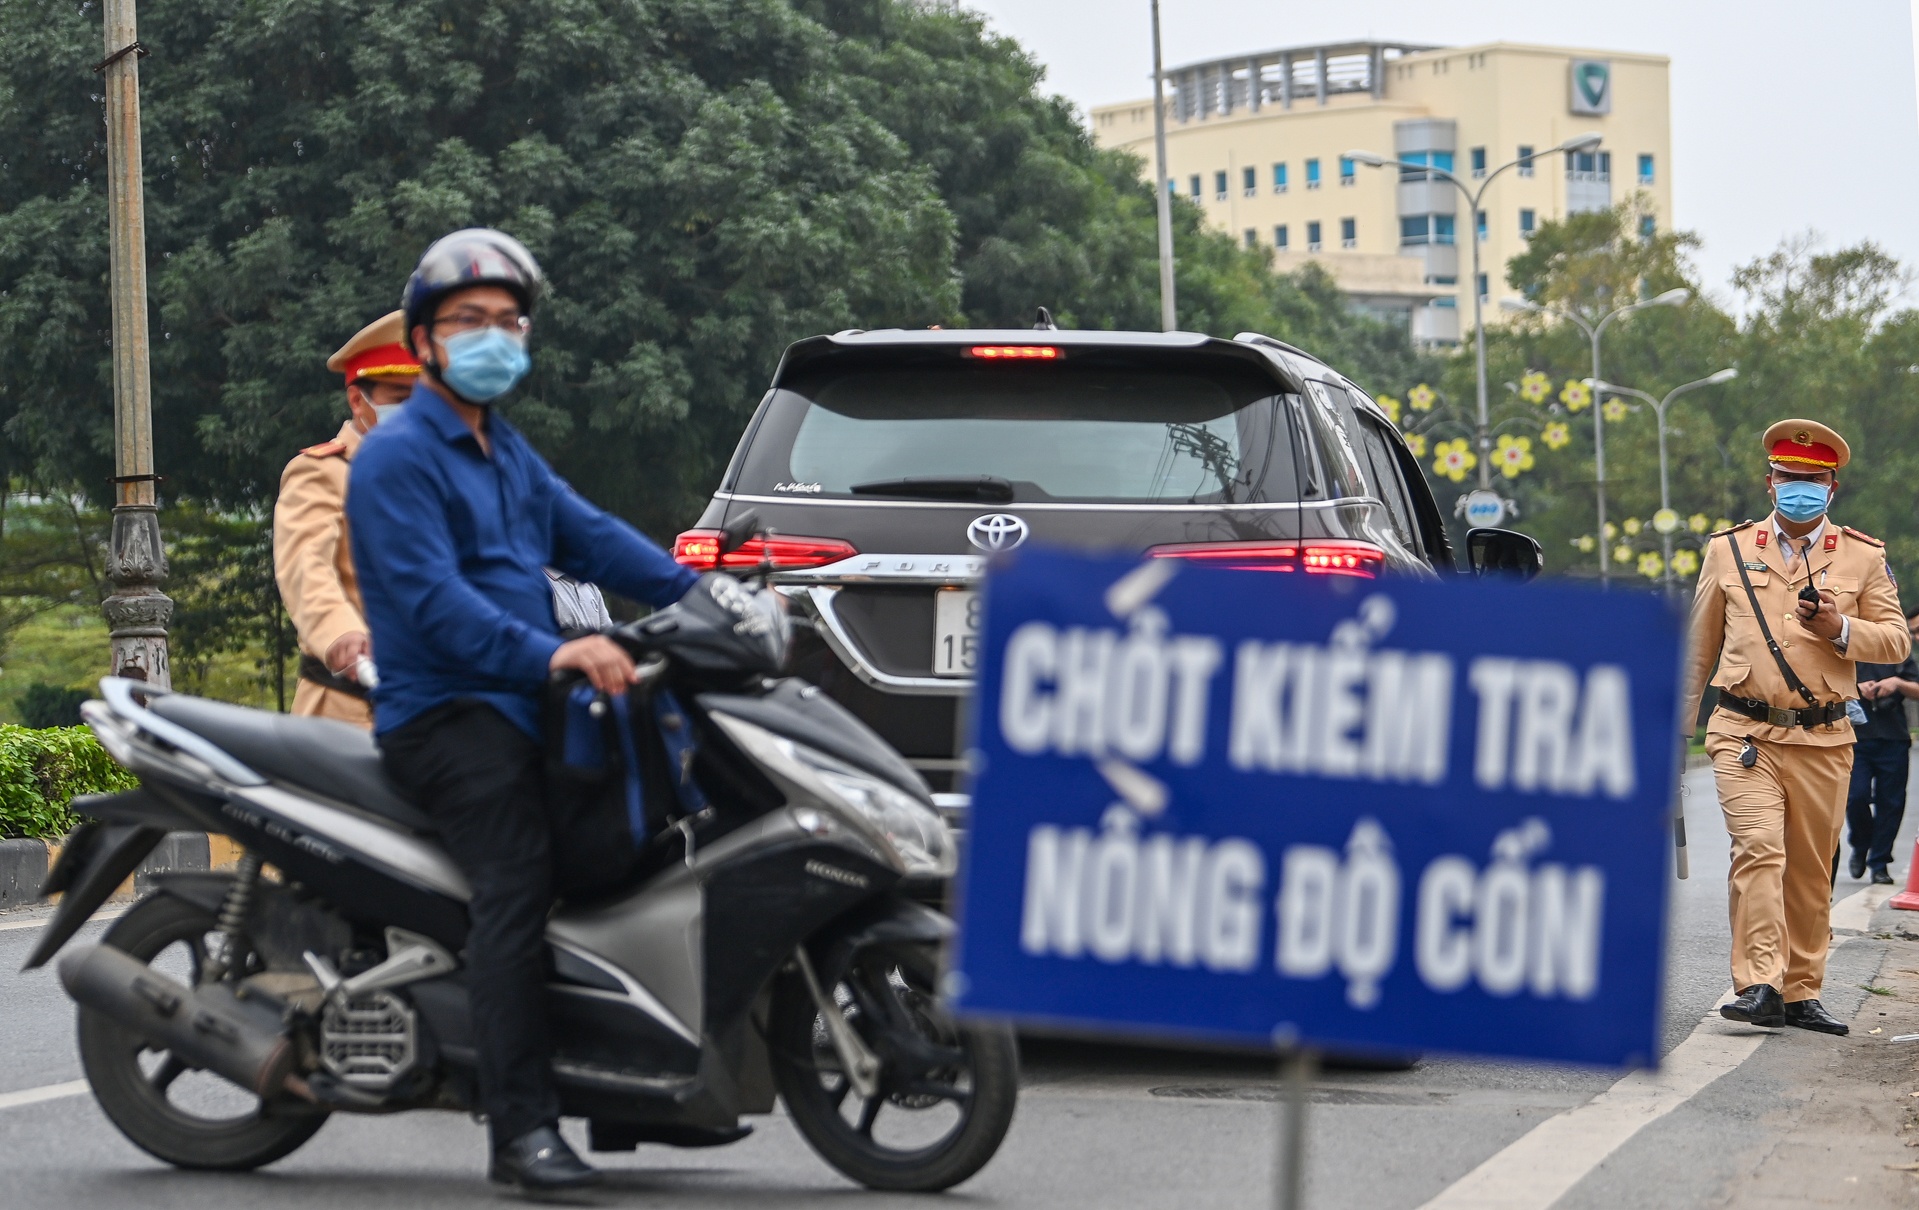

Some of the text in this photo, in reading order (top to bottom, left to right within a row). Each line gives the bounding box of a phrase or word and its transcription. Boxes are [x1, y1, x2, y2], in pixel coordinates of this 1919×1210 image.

[1000, 560, 1635, 799] CHỐT KIỂM TRA
[804, 859, 869, 887] HONDA
[1021, 760, 1266, 972] NỒNG
[1276, 816, 1402, 1009] ĐỘ
